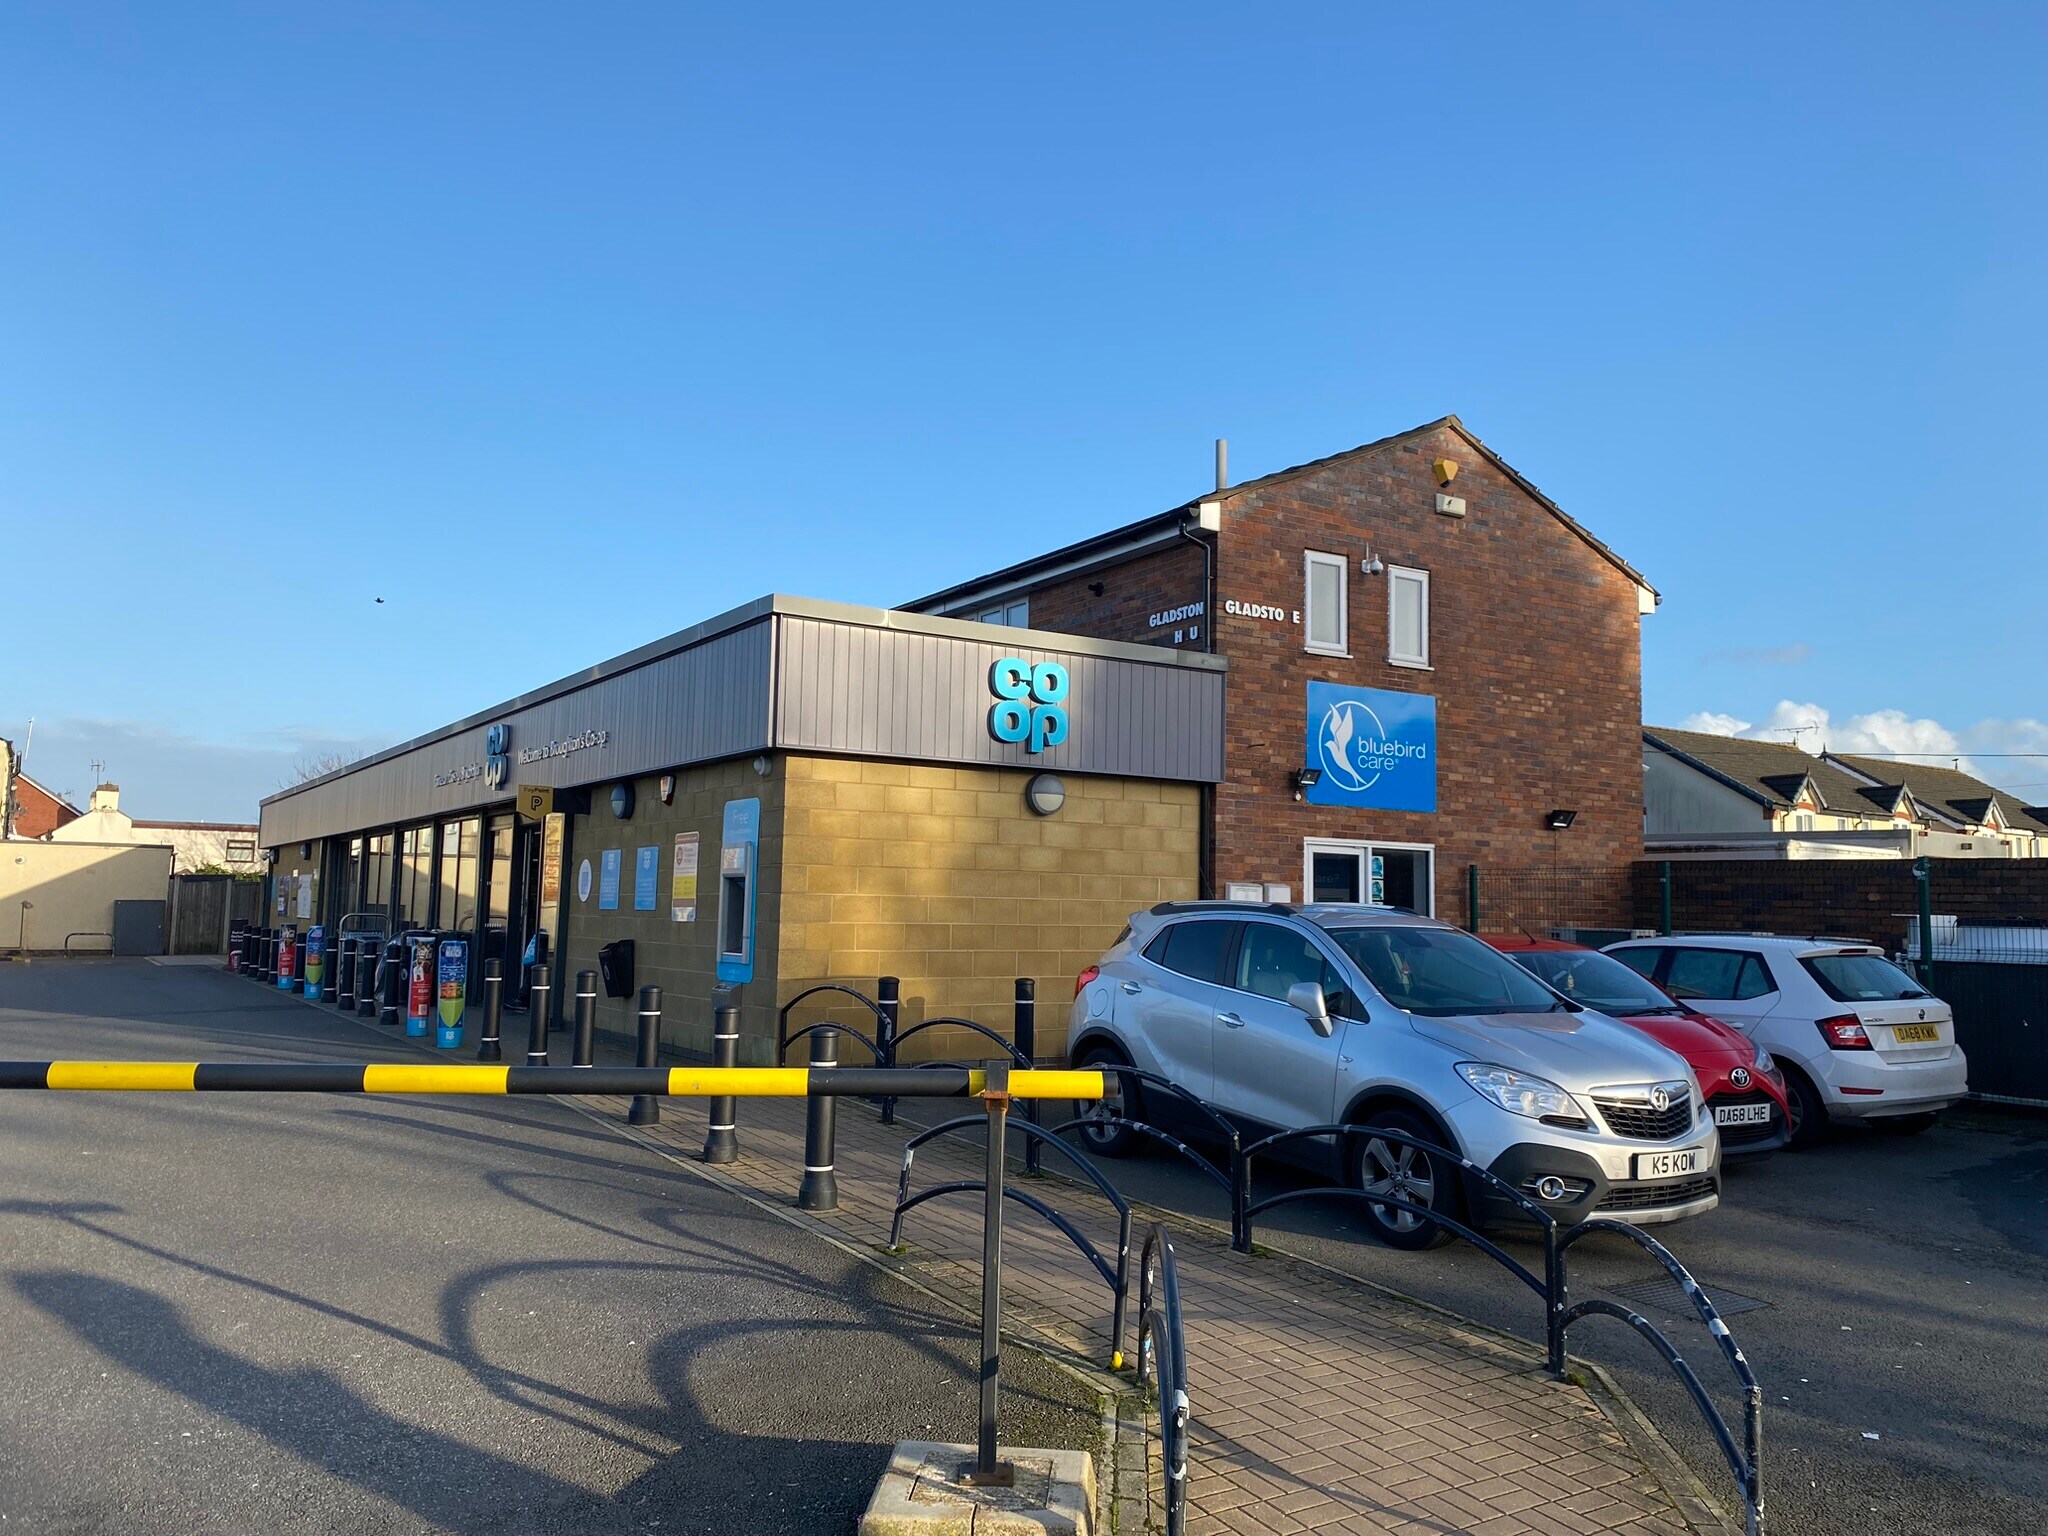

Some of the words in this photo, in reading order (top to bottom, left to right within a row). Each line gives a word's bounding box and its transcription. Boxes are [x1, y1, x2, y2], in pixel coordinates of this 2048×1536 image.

[585, 729, 606, 748] Co-op
[1358, 736, 1426, 759] bluebird
[733, 809, 749, 825] Free
[1897, 1026, 1920, 1040] DA68
[1921, 1025, 1937, 1039] KWK
[1720, 1108, 1745, 1123] DA68
[1747, 1106, 1766, 1121] LHE
[1652, 1156, 1669, 1174] K5
[1672, 1152, 1696, 1172] KOW
